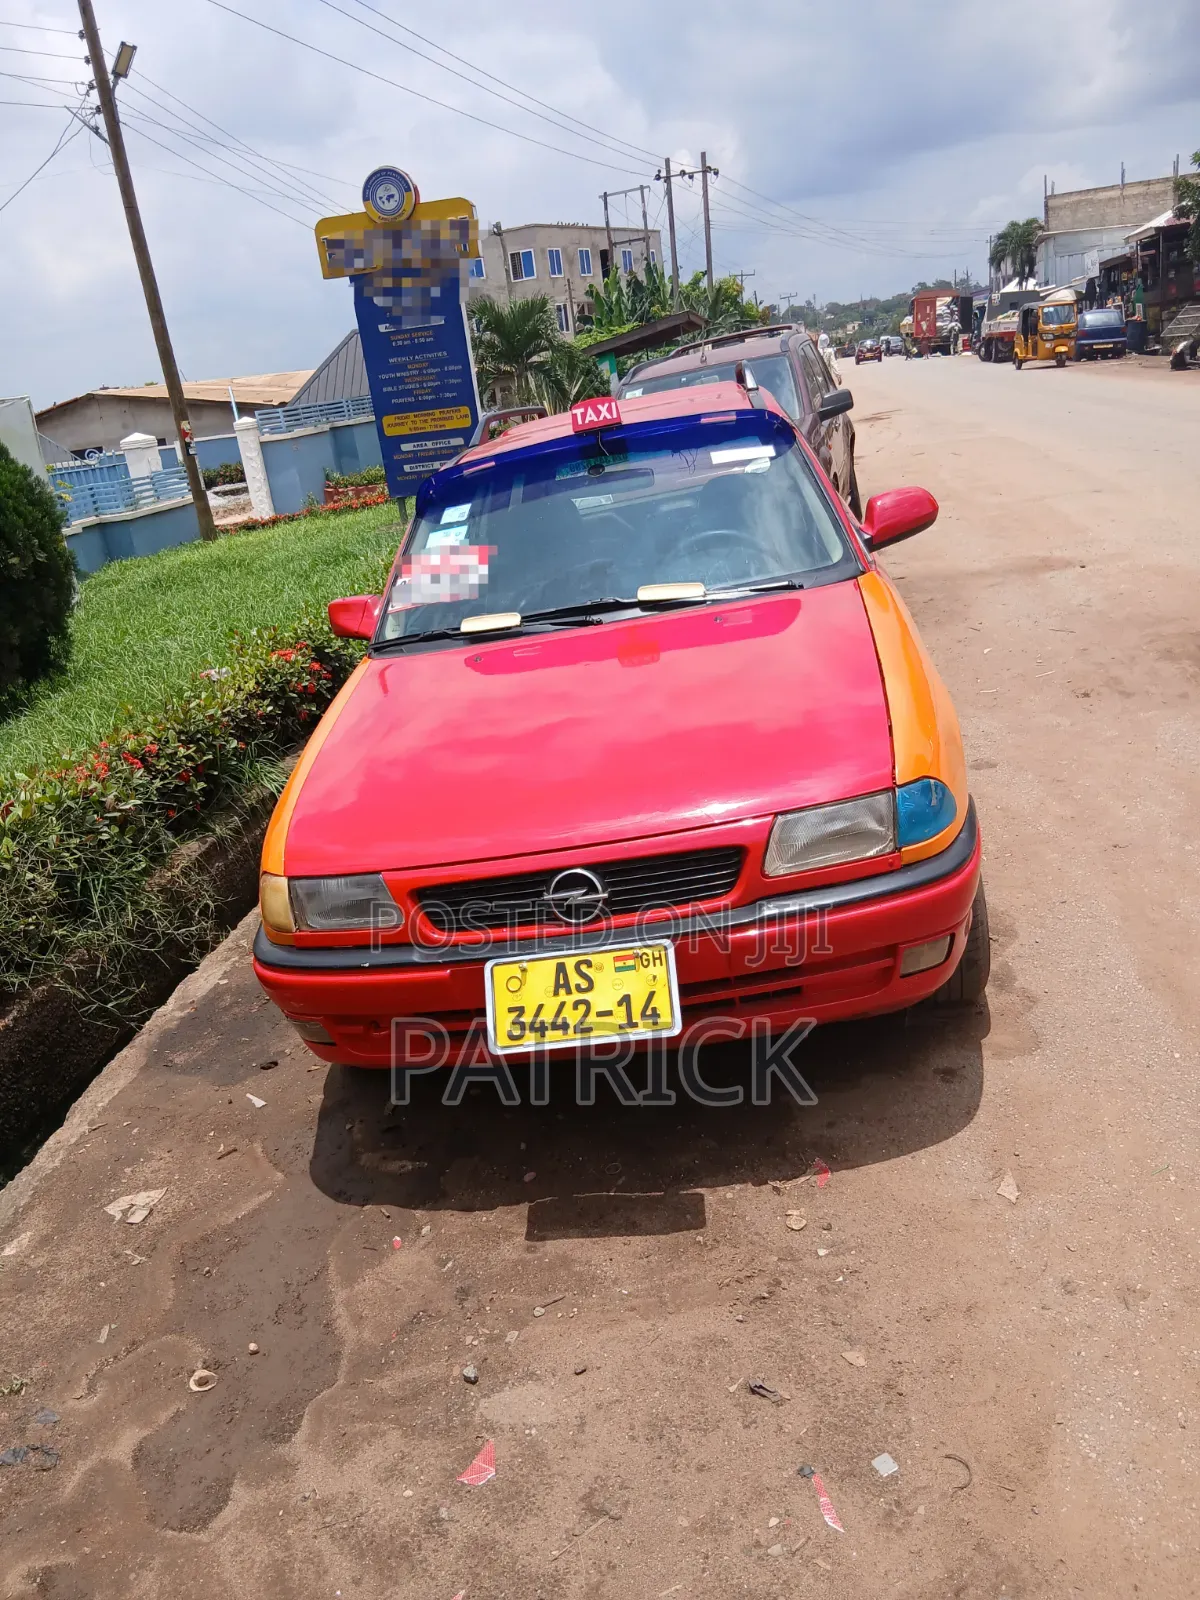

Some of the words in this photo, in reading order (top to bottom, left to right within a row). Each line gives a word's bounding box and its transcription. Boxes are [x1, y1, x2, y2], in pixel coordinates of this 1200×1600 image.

[389, 355, 413, 363] WEEKLY
[415, 351, 447, 360] ACTIVITIES
[396, 370, 419, 378] MINISTRY
[404, 375, 436, 383] WEDNESDAY
[399, 383, 419, 391] STUDIES
[392, 396, 415, 404] PRAYERS
[414, 411, 435, 419] MORNING
[572, 402, 618, 425] TAXI
[430, 415, 454, 423] PROMISED
[393, 452, 413, 460] MONDAY
[639, 950, 664, 969] GH
[552, 958, 595, 997] AS
[506, 990, 661, 1041] 3442-14
